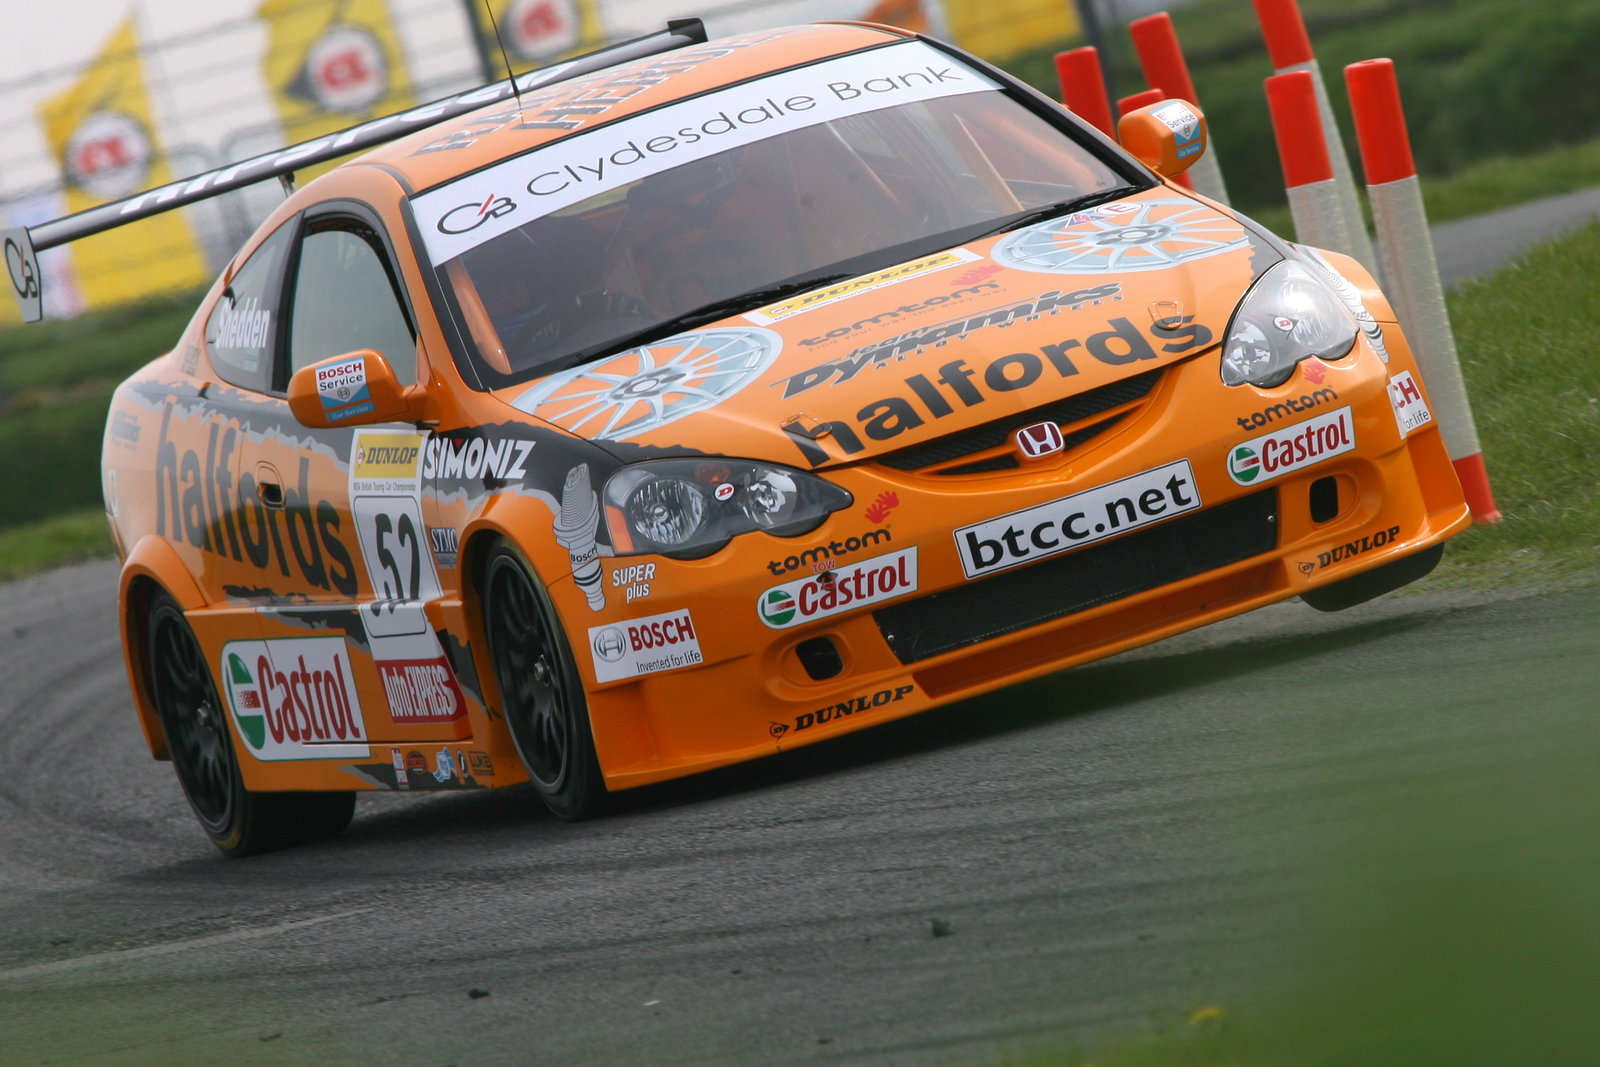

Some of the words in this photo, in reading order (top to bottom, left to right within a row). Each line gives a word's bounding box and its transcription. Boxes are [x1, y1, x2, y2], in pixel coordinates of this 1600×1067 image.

[526, 95, 818, 196] Clydesdale
[826, 65, 963, 102] Bank
[1166, 112, 1197, 130] Service
[800, 256, 951, 304] DUNLOP
[214, 297, 271, 349] Shedden
[797, 281, 1000, 347] tomtom
[318, 362, 363, 381] BOSCH
[319, 374, 363, 392] Service
[783, 313, 1213, 469] halfords
[1236, 387, 1339, 432] tomtom
[1412, 410, 1430, 426] life
[366, 447, 418, 465] DUNLOP
[424, 436, 536, 480] SIMONIZ
[1262, 414, 1350, 473] Castrol
[155, 398, 359, 600] halfords
[965, 473, 1193, 570] btcc.net
[370, 513, 421, 618] 52
[767, 528, 892, 576] tomtom
[811, 560, 837, 574] TOW
[1317, 525, 1400, 569] DUNLOP
[612, 563, 656, 587] SUPER
[626, 581, 650, 604] plus
[799, 555, 910, 616] Castrol
[628, 615, 695, 652] BOSCH
[636, 655, 671, 673] Invented
[670, 653, 684, 667] for
[684, 649, 701, 664] life
[257, 653, 361, 744] Castrol
[794, 684, 914, 732] DUNLOP
